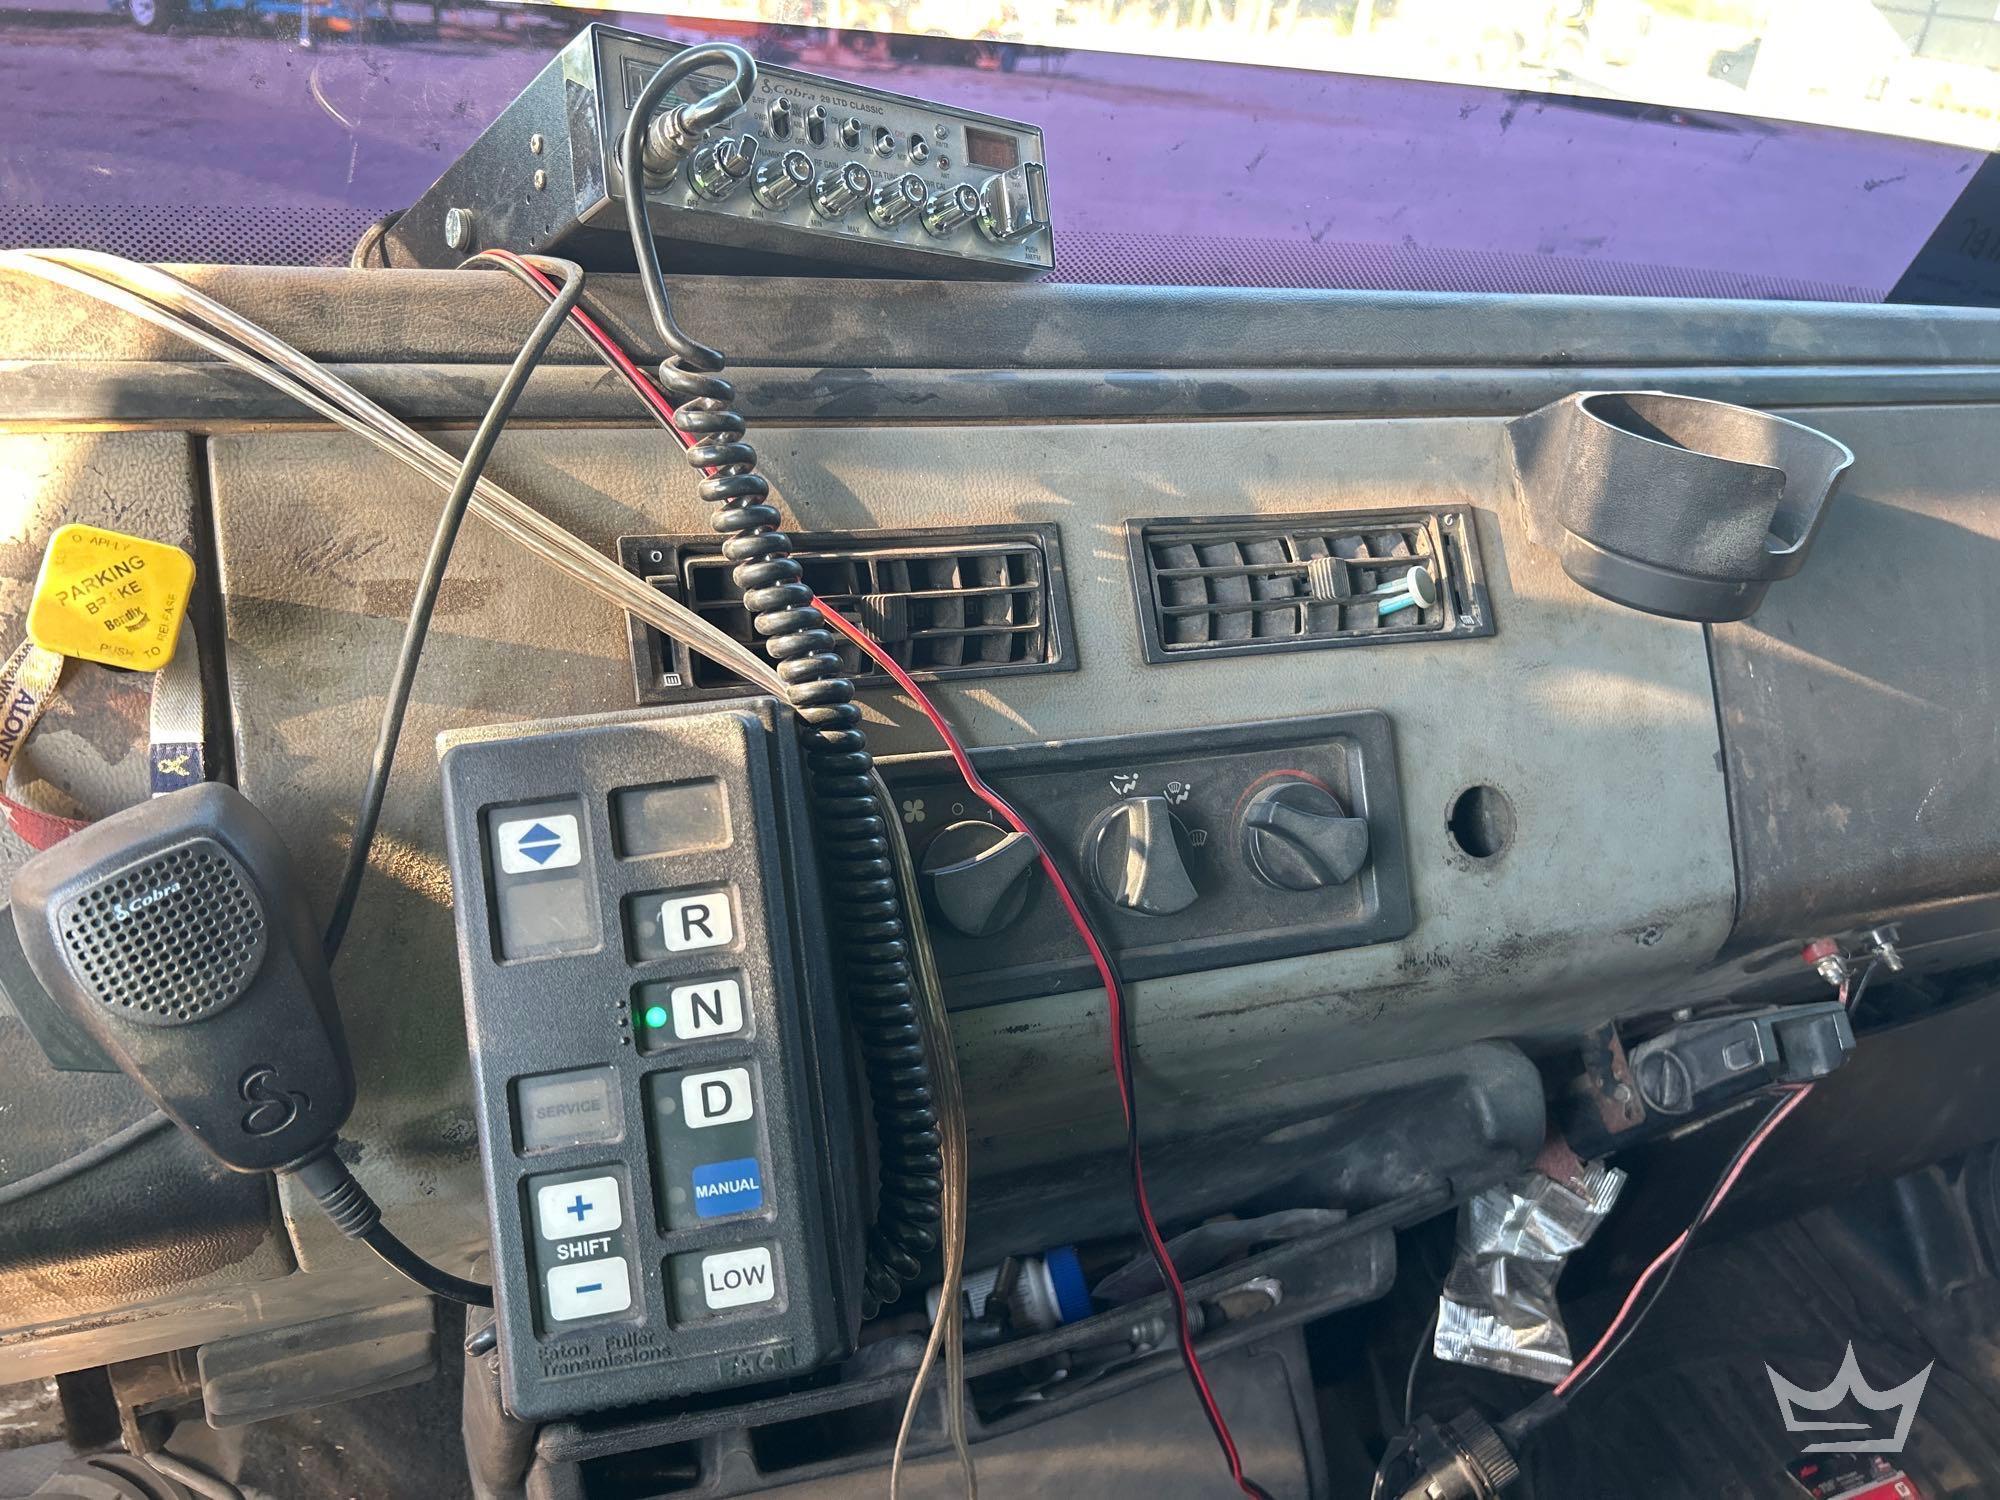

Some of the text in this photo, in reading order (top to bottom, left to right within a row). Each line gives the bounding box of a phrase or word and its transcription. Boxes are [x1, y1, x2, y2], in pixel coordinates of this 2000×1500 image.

[774, 84, 816, 101] Cobra
[833, 97, 848, 107] LTD
[850, 101, 884, 115] CLASSIC
[56, 555, 145, 607] PARKING
[144, 646, 161, 658] TO
[129, 882, 181, 912] Cobra
[681, 904, 713, 942] R
[691, 989, 723, 1029] N
[536, 1099, 602, 1119] SERVICE
[701, 1080, 733, 1118] D
[695, 1178, 760, 1199] MANUAL
[556, 1238, 612, 1260] SHIFT
[710, 1264, 766, 1292] LOW
[543, 1345, 672, 1378] Transmissions
